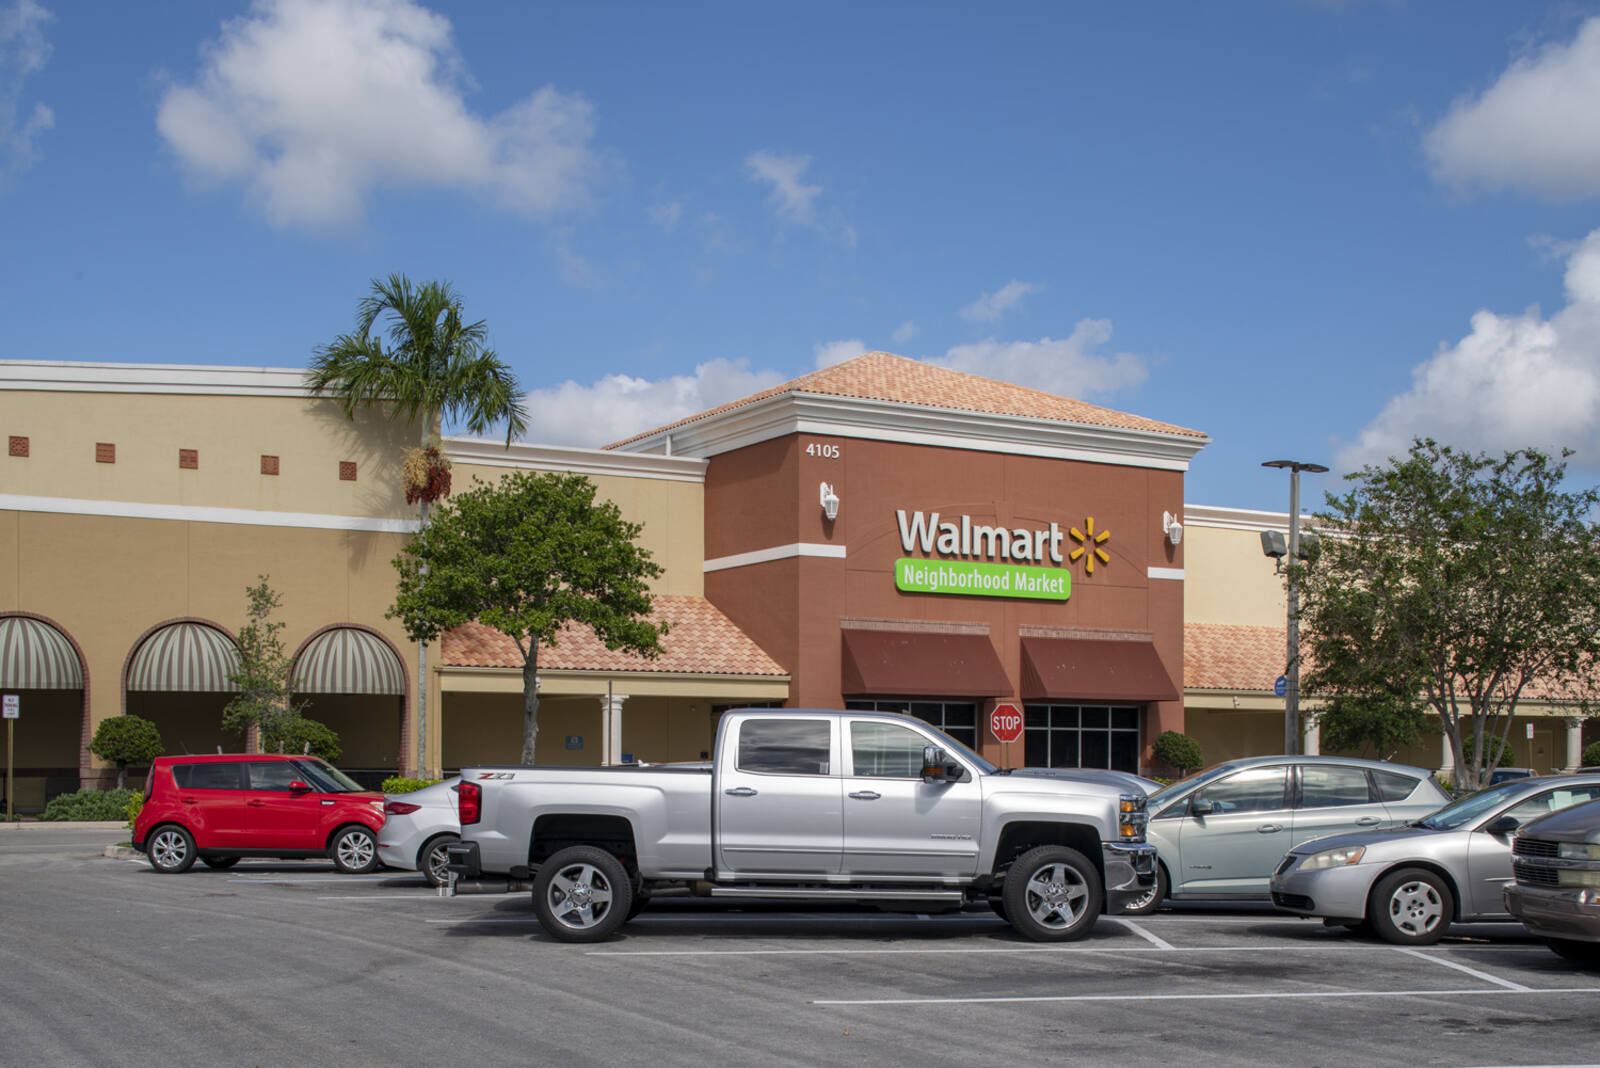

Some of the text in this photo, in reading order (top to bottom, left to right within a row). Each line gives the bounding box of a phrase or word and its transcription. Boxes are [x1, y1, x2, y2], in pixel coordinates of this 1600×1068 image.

[806, 443, 840, 459] 4105
[896, 510, 1064, 562] Walmart
[904, 565, 1064, 593] Neighborhood Market
[993, 715, 1020, 730] STOP
